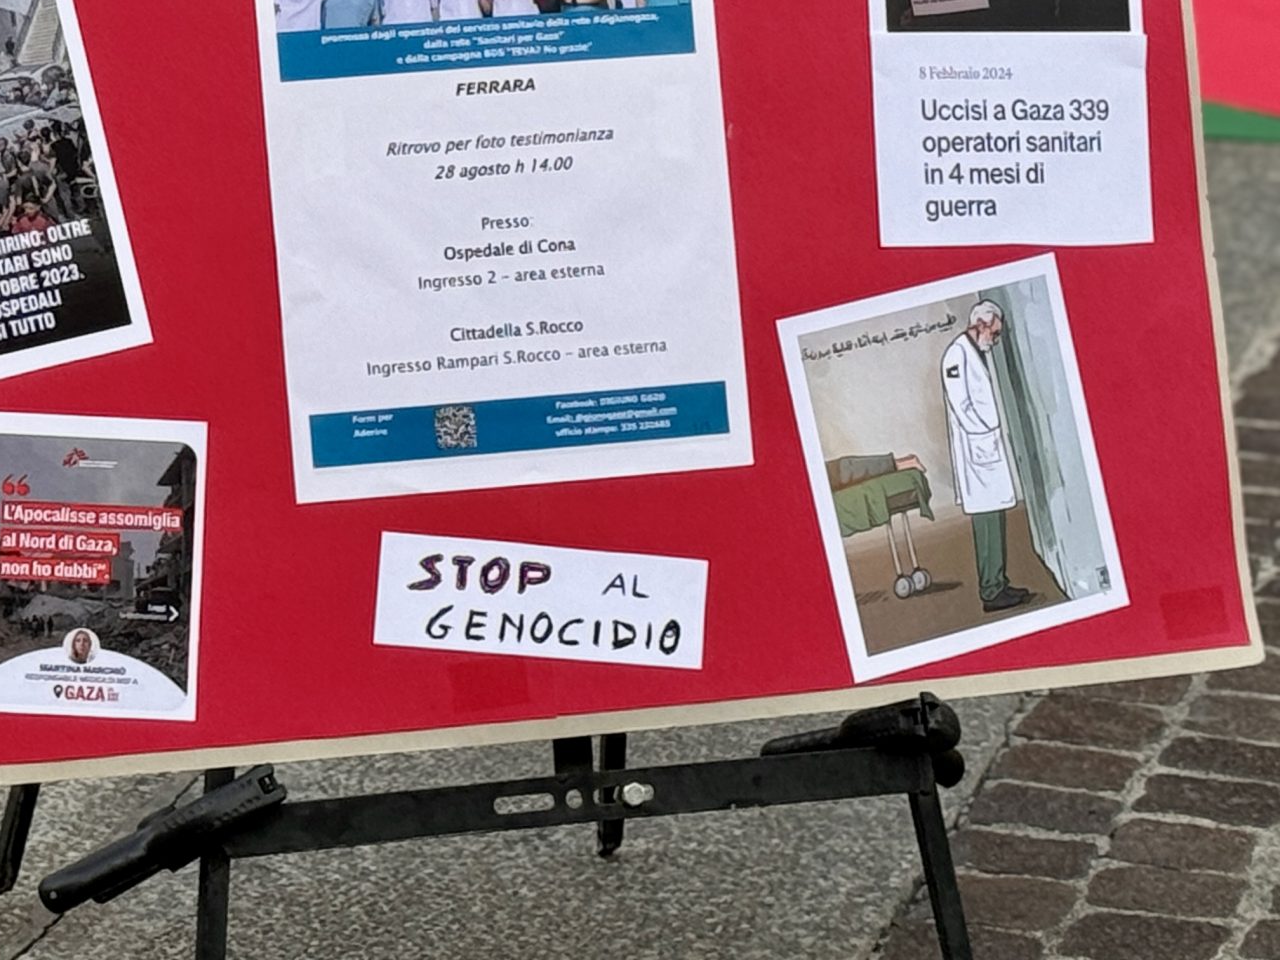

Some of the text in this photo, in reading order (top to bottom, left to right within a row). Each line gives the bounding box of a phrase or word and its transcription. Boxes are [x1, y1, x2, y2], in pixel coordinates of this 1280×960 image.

[918, 66, 1013, 80] 8 Febbraio 2024
[455, 78, 536, 97] FERRARA
[920, 98, 1109, 121] Uccisi a Gaza 339
[386, 127, 614, 157] Ritrovo per foto testimonianza
[922, 130, 1102, 157] operatori sanitari
[434, 155, 574, 181] 28 agosto h 14.00
[923, 162, 1045, 185] in 4 mesi di
[925, 197, 997, 222] guerra
[46, 218, 92, 243] OLTRE
[31, 243, 73, 268] SONO
[444, 238, 576, 263] Ospedale di Cona
[40, 263, 86, 288] 2023.
[418, 263, 605, 291] Ingresso 2 area esterna
[8, 311, 57, 337] TUTTO
[449, 319, 584, 342] Cittadella S.Rocco
[366, 339, 666, 377] Ingresso Rampari S.Rocco area esterna
[3, 503, 181, 530] L'Apocalisse assomiglia
[2, 533, 118, 555] al Nord di Gaza,
[0, 561, 30, 576] non
[32, 560, 52, 577] ho
[407, 553, 650, 599] STOP AL
[425, 604, 681, 656] GENOCIDIO
[64, 684, 106, 701] GAZA
